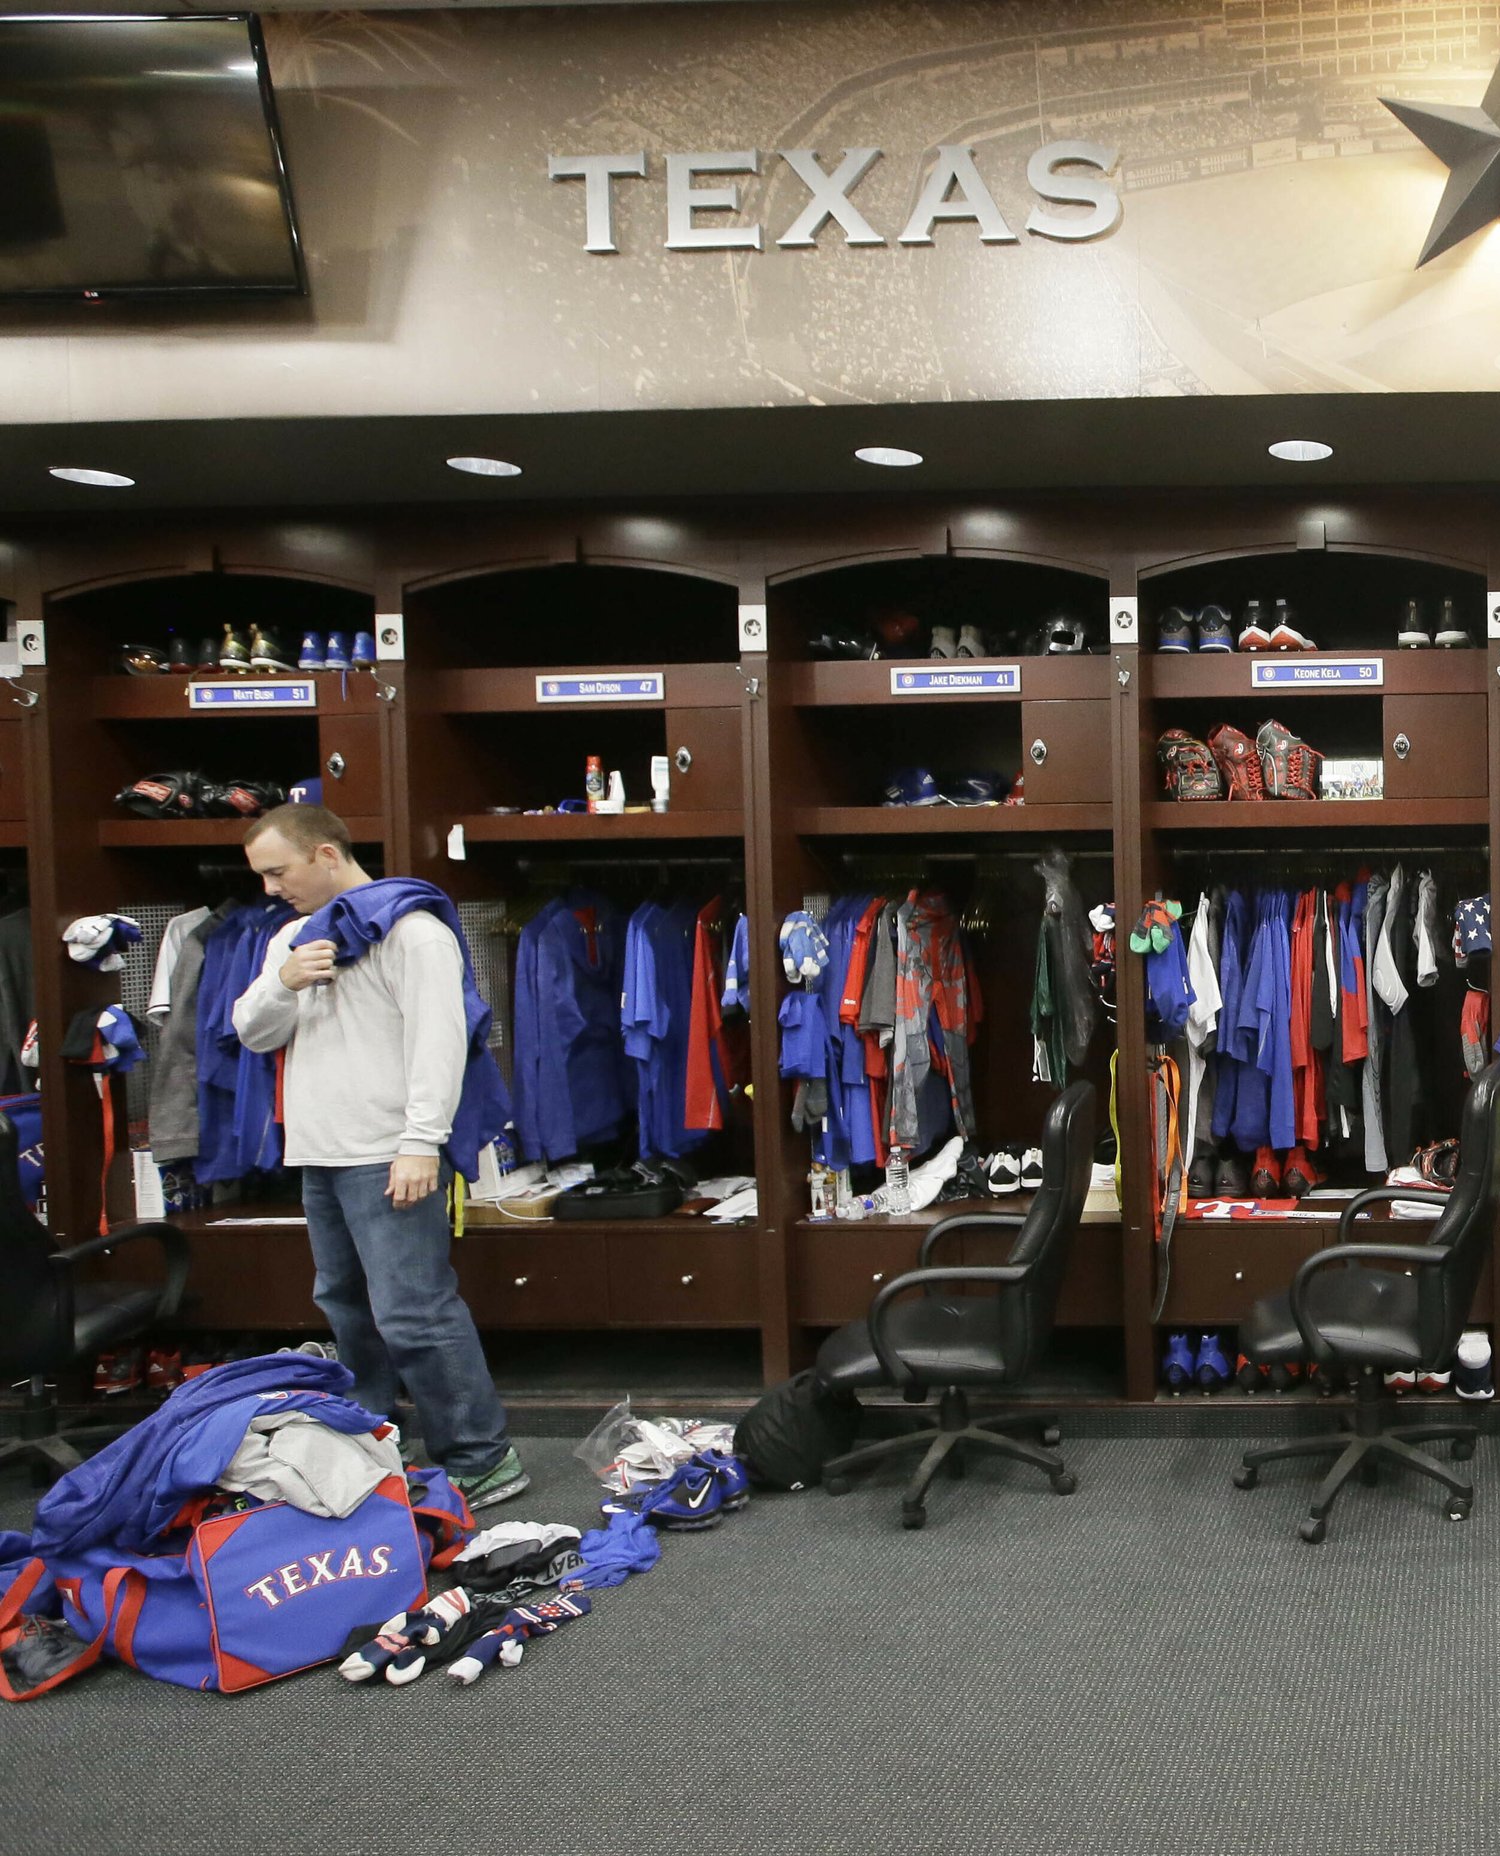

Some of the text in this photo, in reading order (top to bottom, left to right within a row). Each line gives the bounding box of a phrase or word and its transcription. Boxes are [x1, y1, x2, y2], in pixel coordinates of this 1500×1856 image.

[548, 138, 1124, 254] TEXAS
[929, 673, 1009, 686] JAKE DIEKMAN 41
[1294, 667, 1372, 679] KEONE KELA 50
[233, 688, 305, 700] MATT BUSH 51
[579, 681, 653, 694] SAM DYSON 47
[289, 787, 307, 803] T
[1194, 1200, 1259, 1219] T
[244, 1545, 392, 1609] TEXAS
